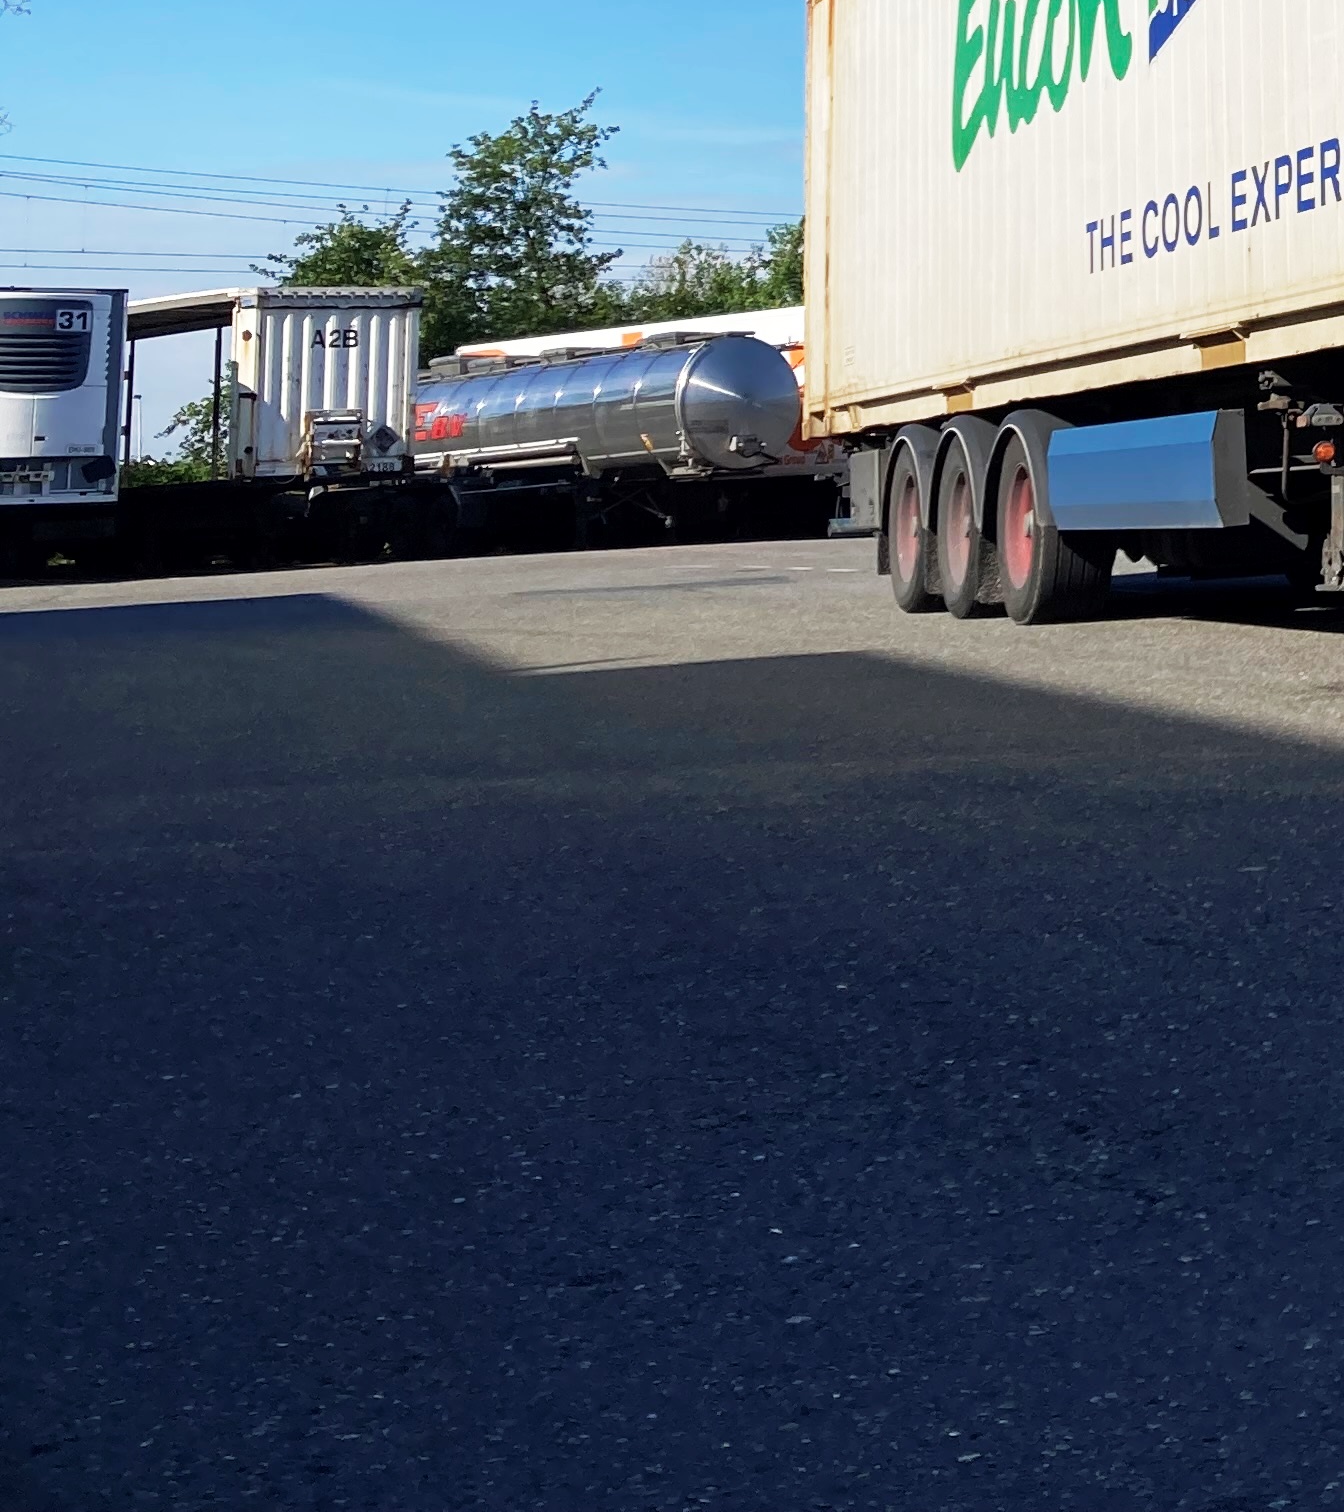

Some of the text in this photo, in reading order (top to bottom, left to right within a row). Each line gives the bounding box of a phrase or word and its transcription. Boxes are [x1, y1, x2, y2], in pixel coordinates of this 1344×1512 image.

[1086, 210, 1134, 275] THE
[1141, 181, 1221, 259] COOL
[58, 311, 88, 330] 31
